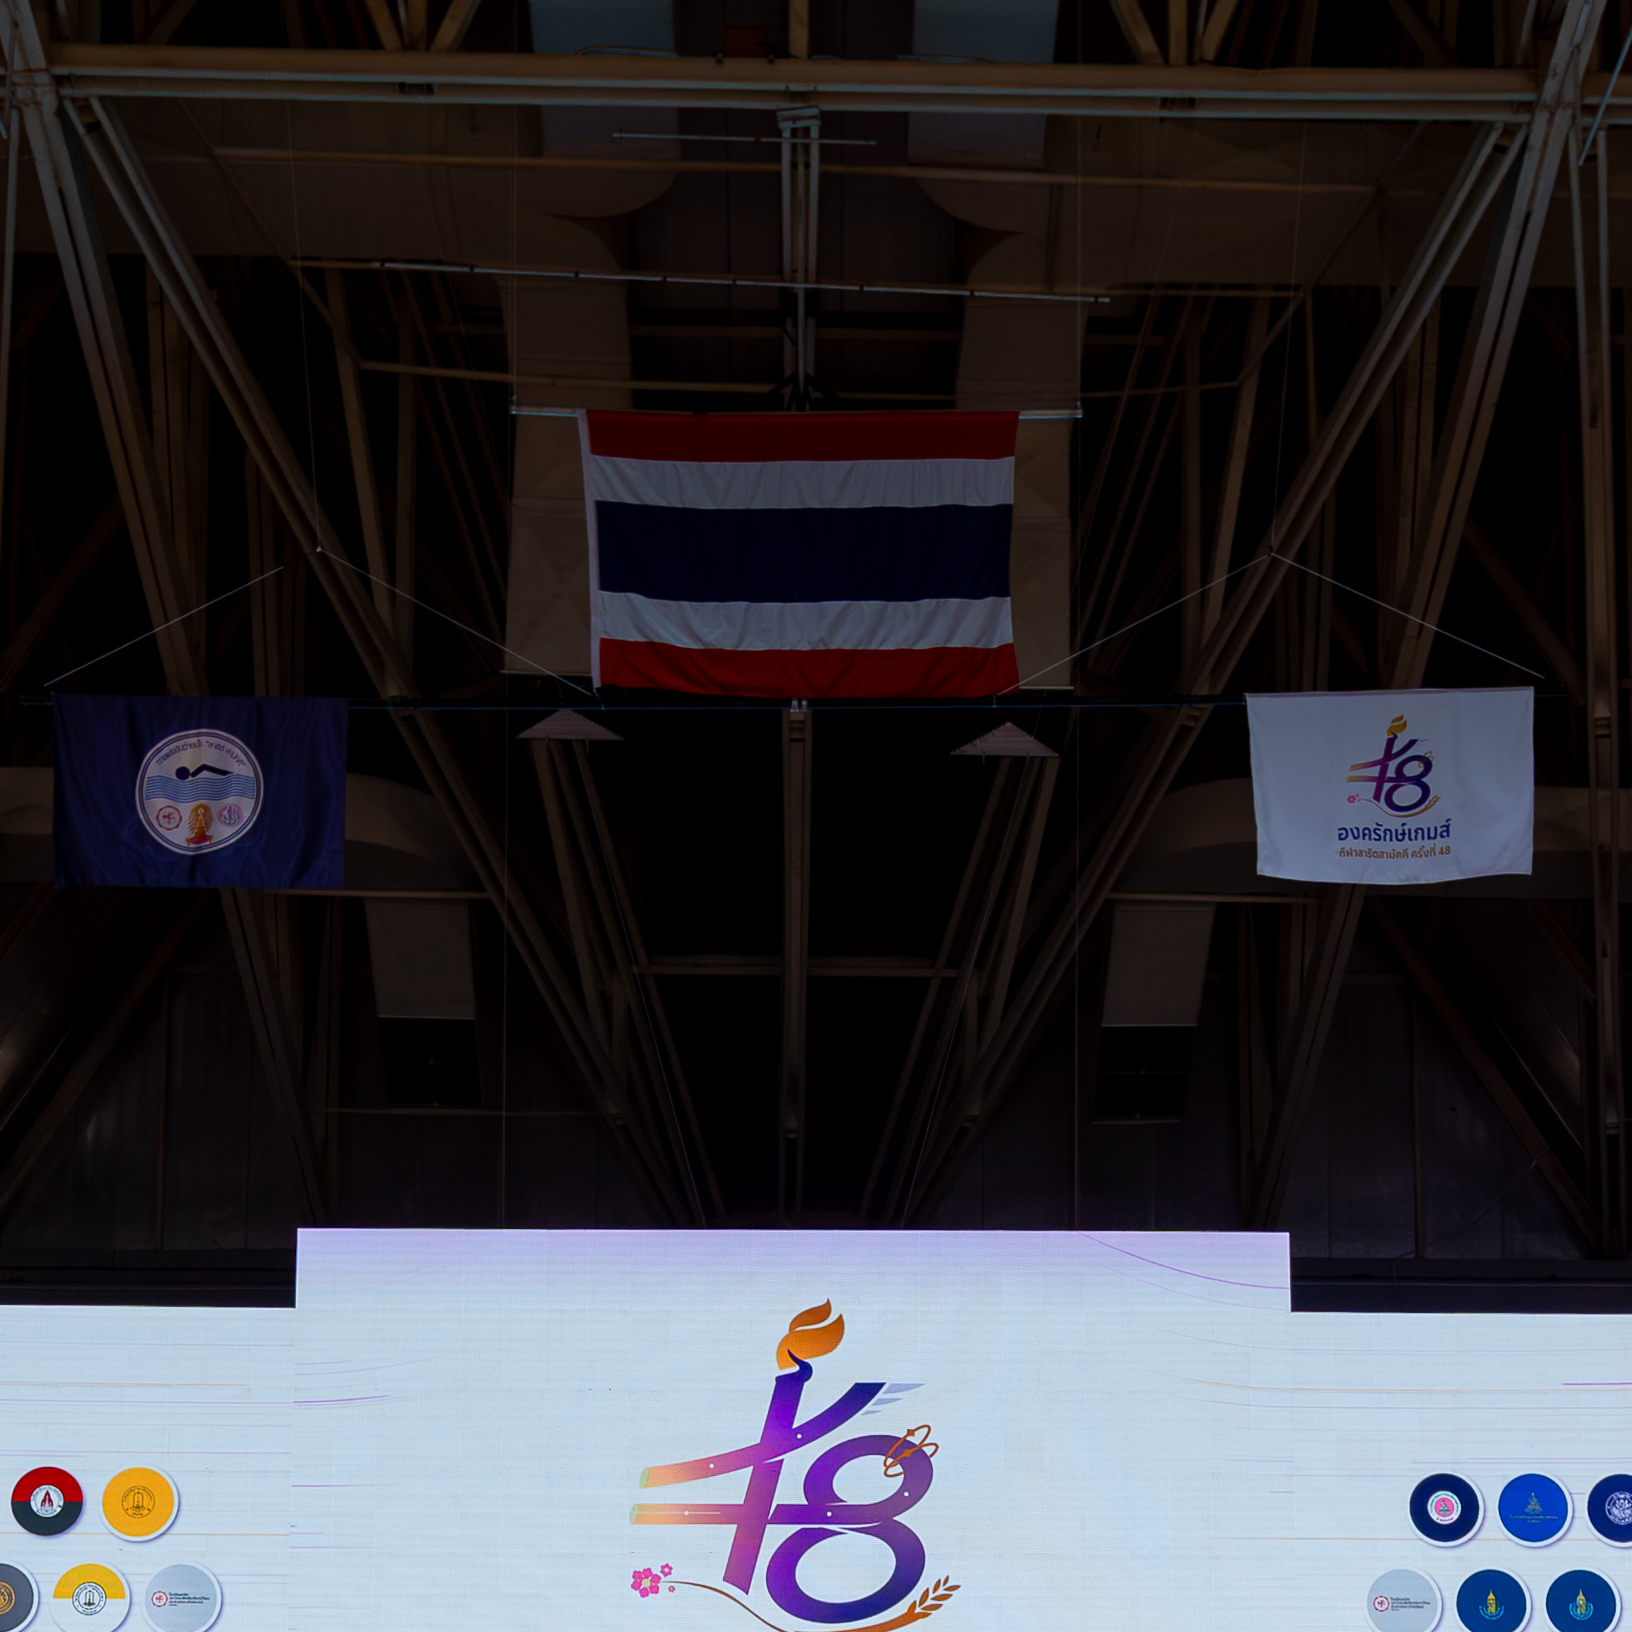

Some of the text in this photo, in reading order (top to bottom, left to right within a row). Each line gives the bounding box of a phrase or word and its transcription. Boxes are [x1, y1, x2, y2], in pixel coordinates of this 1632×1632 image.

[1337, 818, 1452, 843] องครักษ์เกมส์
[1438, 845, 1451, 856] 48
